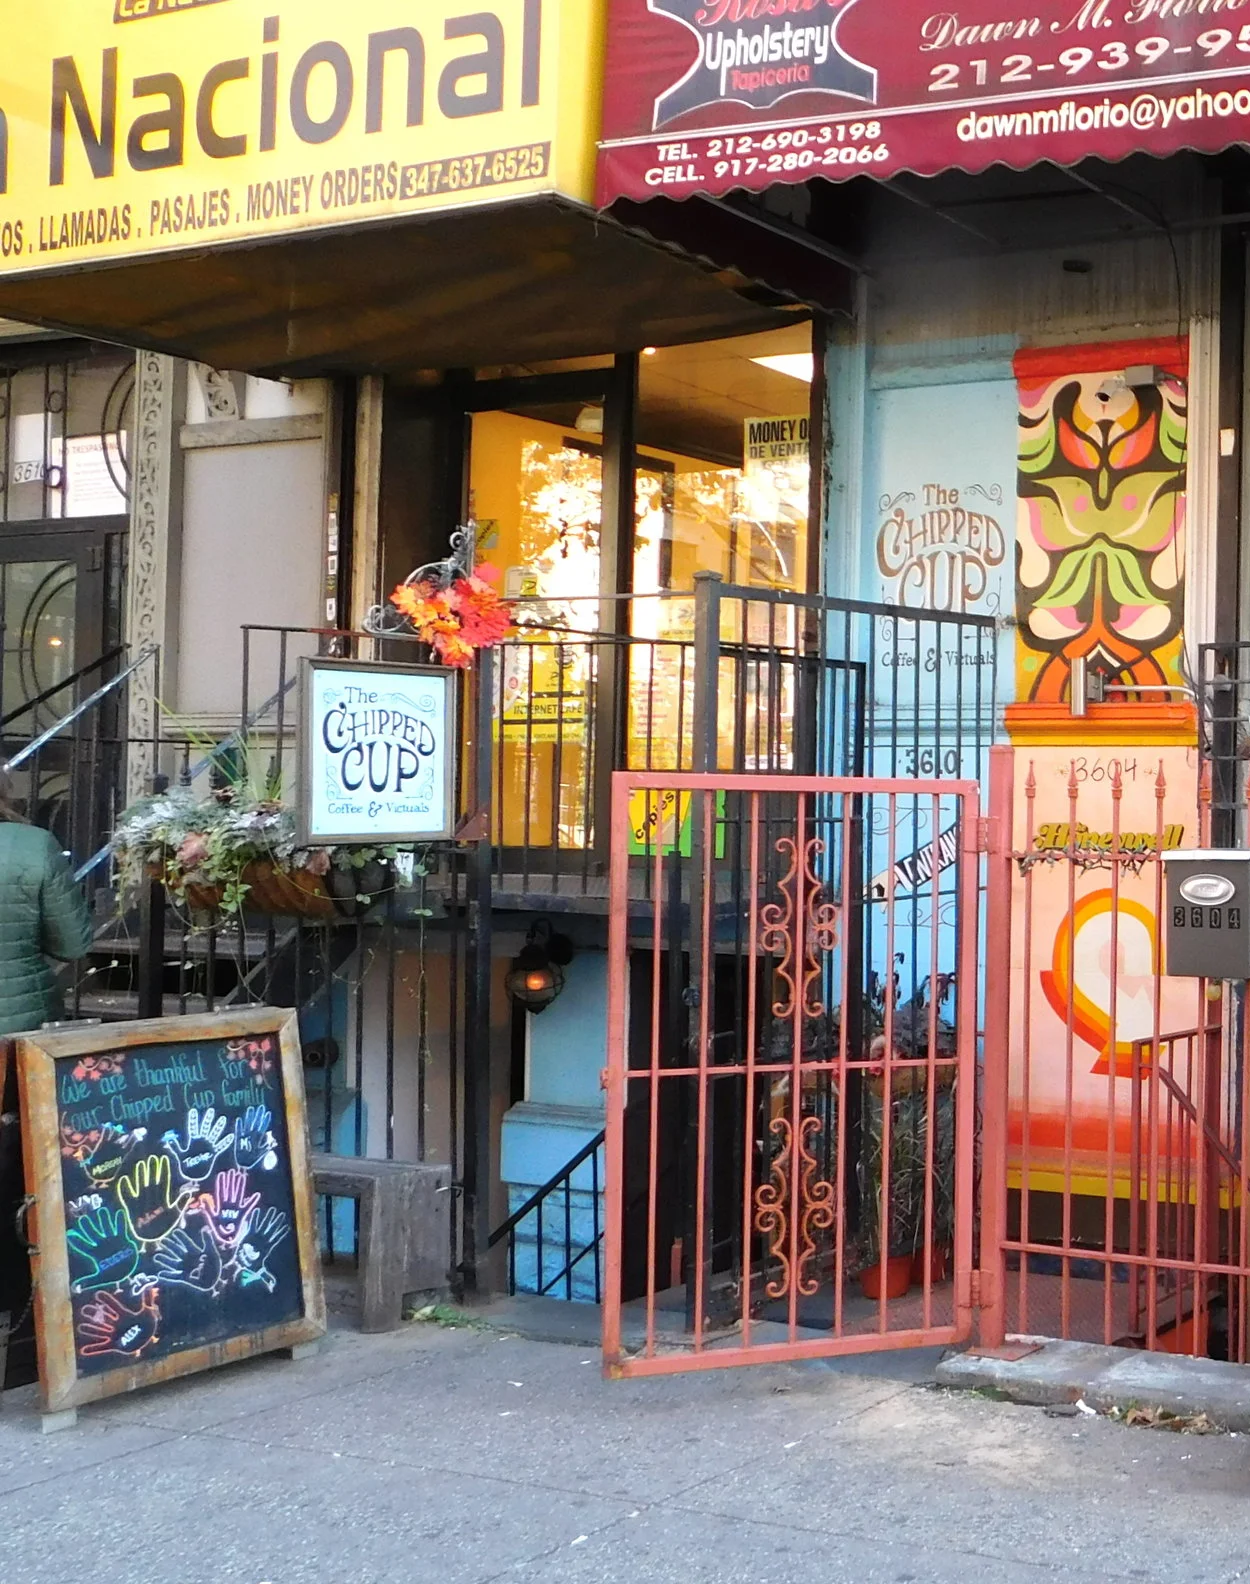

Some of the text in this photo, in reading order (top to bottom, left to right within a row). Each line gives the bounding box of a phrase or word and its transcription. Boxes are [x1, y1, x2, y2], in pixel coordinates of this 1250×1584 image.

[918, 12, 1043, 51] Dawn
[705, 21, 829, 96] Upholstery
[49, 0, 542, 186] Nacional
[656, 121, 881, 162] TEL. 212-690-3198
[644, 143, 889, 185] CELL. 917-280-2066
[39, 204, 131, 252] LLAMADAS
[150, 190, 230, 236] PASAJES
[247, 174, 314, 221] MONEY
[320, 161, 399, 210] ORDERS
[406, 146, 544, 196] 347-637-6525
[749, 420, 796, 444] MONEY
[750, 445, 765, 459] DE
[922, 484, 959, 506] The
[876, 508, 1005, 579] CHIPPED
[899, 550, 987, 622] CUP
[924, 647, 942, 672] &
[344, 686, 378, 704] The
[322, 702, 436, 756] CHIPPED
[341, 740, 419, 793] CUP
[905, 749, 958, 775] 360
[1076, 757, 1137, 782] 3604
[328, 802, 364, 814] Coffee
[368, 801, 382, 818] &
[1174, 906, 1240, 928] 3604
[61, 1048, 249, 1105] We are thankful for
[70, 1079, 266, 1131] our Chipped Cup family
[121, 1324, 142, 1347] ALEX
